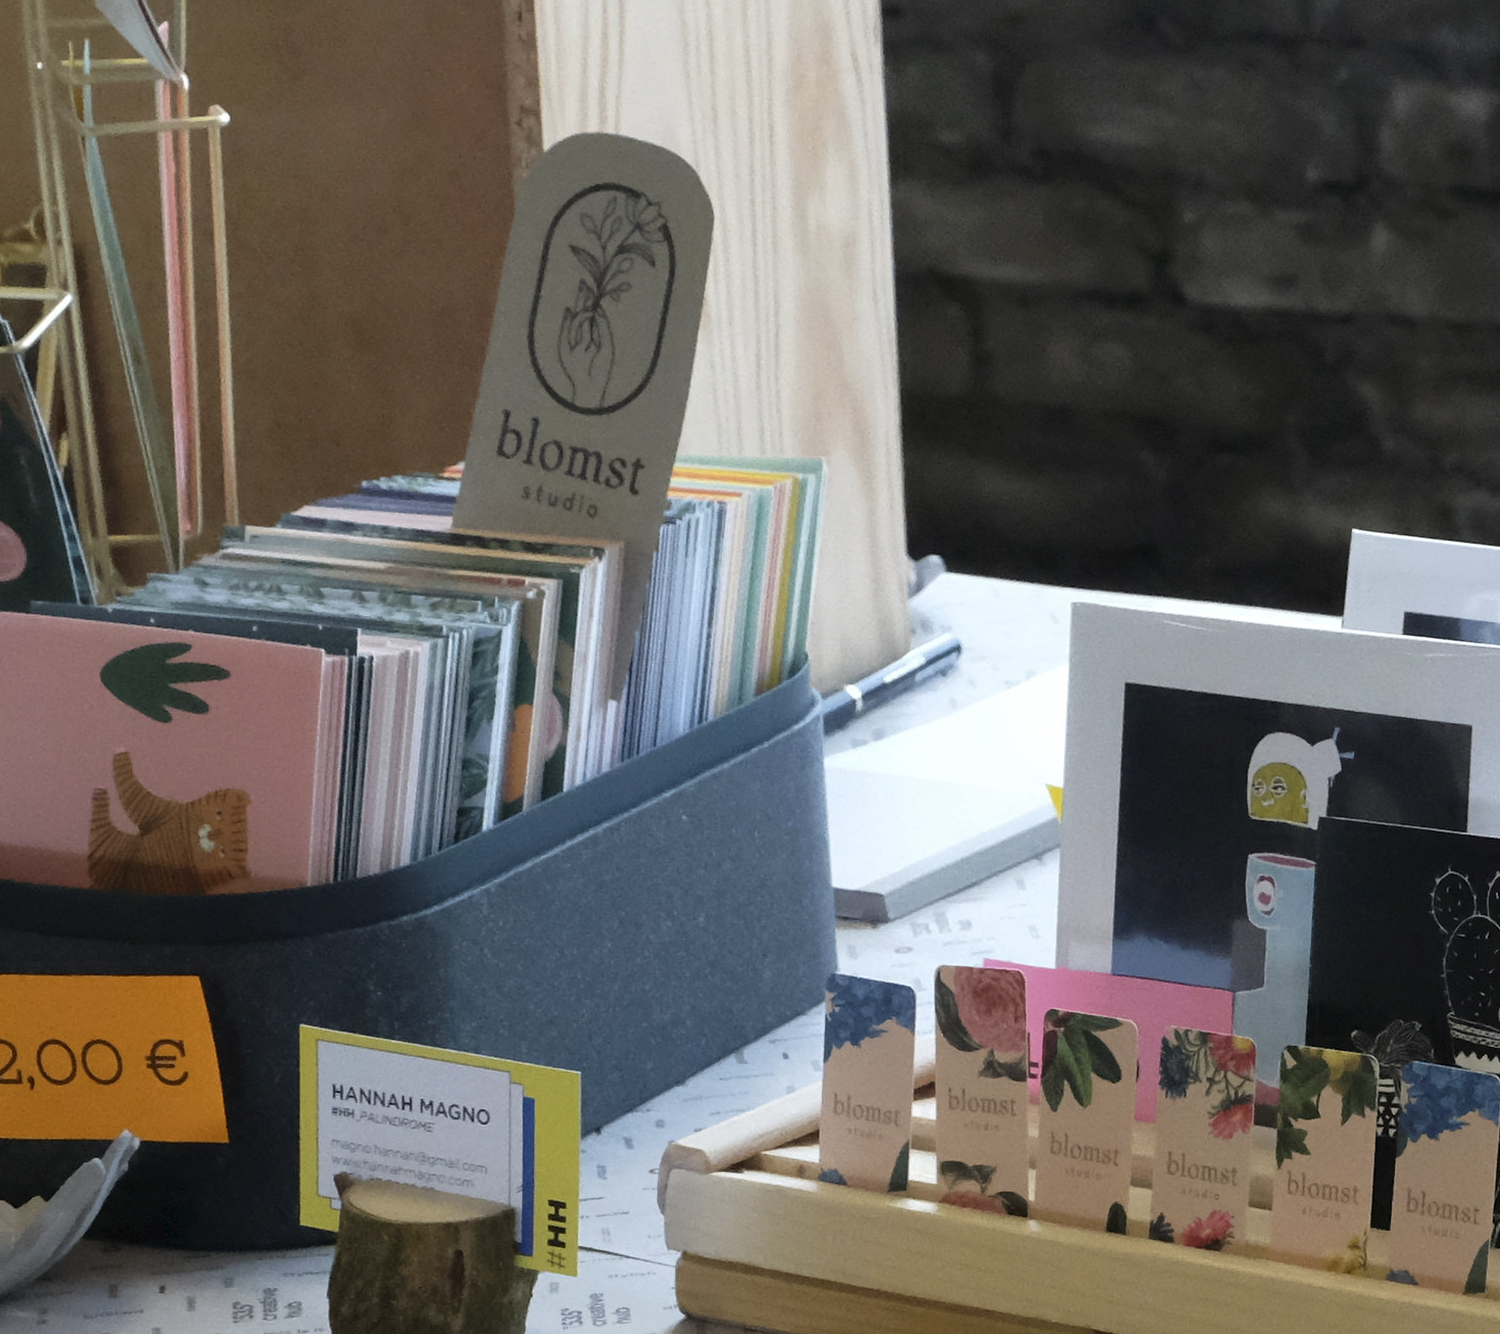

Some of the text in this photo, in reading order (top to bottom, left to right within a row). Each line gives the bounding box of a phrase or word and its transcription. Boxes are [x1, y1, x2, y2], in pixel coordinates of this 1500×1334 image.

[496, 410, 646, 495] blomst
[522, 483, 599, 519] studio
[146, 1038, 190, 1086] €
[332, 1083, 491, 1125] HANNAH MAGNO
[832, 1089, 901, 1127] blomst
[947, 1087, 1018, 1118] blomst
[1049, 1131, 1121, 1167] blomst
[1165, 1151, 1239, 1187] blomst
[1287, 1171, 1360, 1206] blomst
[1406, 1188, 1481, 1226] blomst
[547, 1198, 567, 1269] #HH
